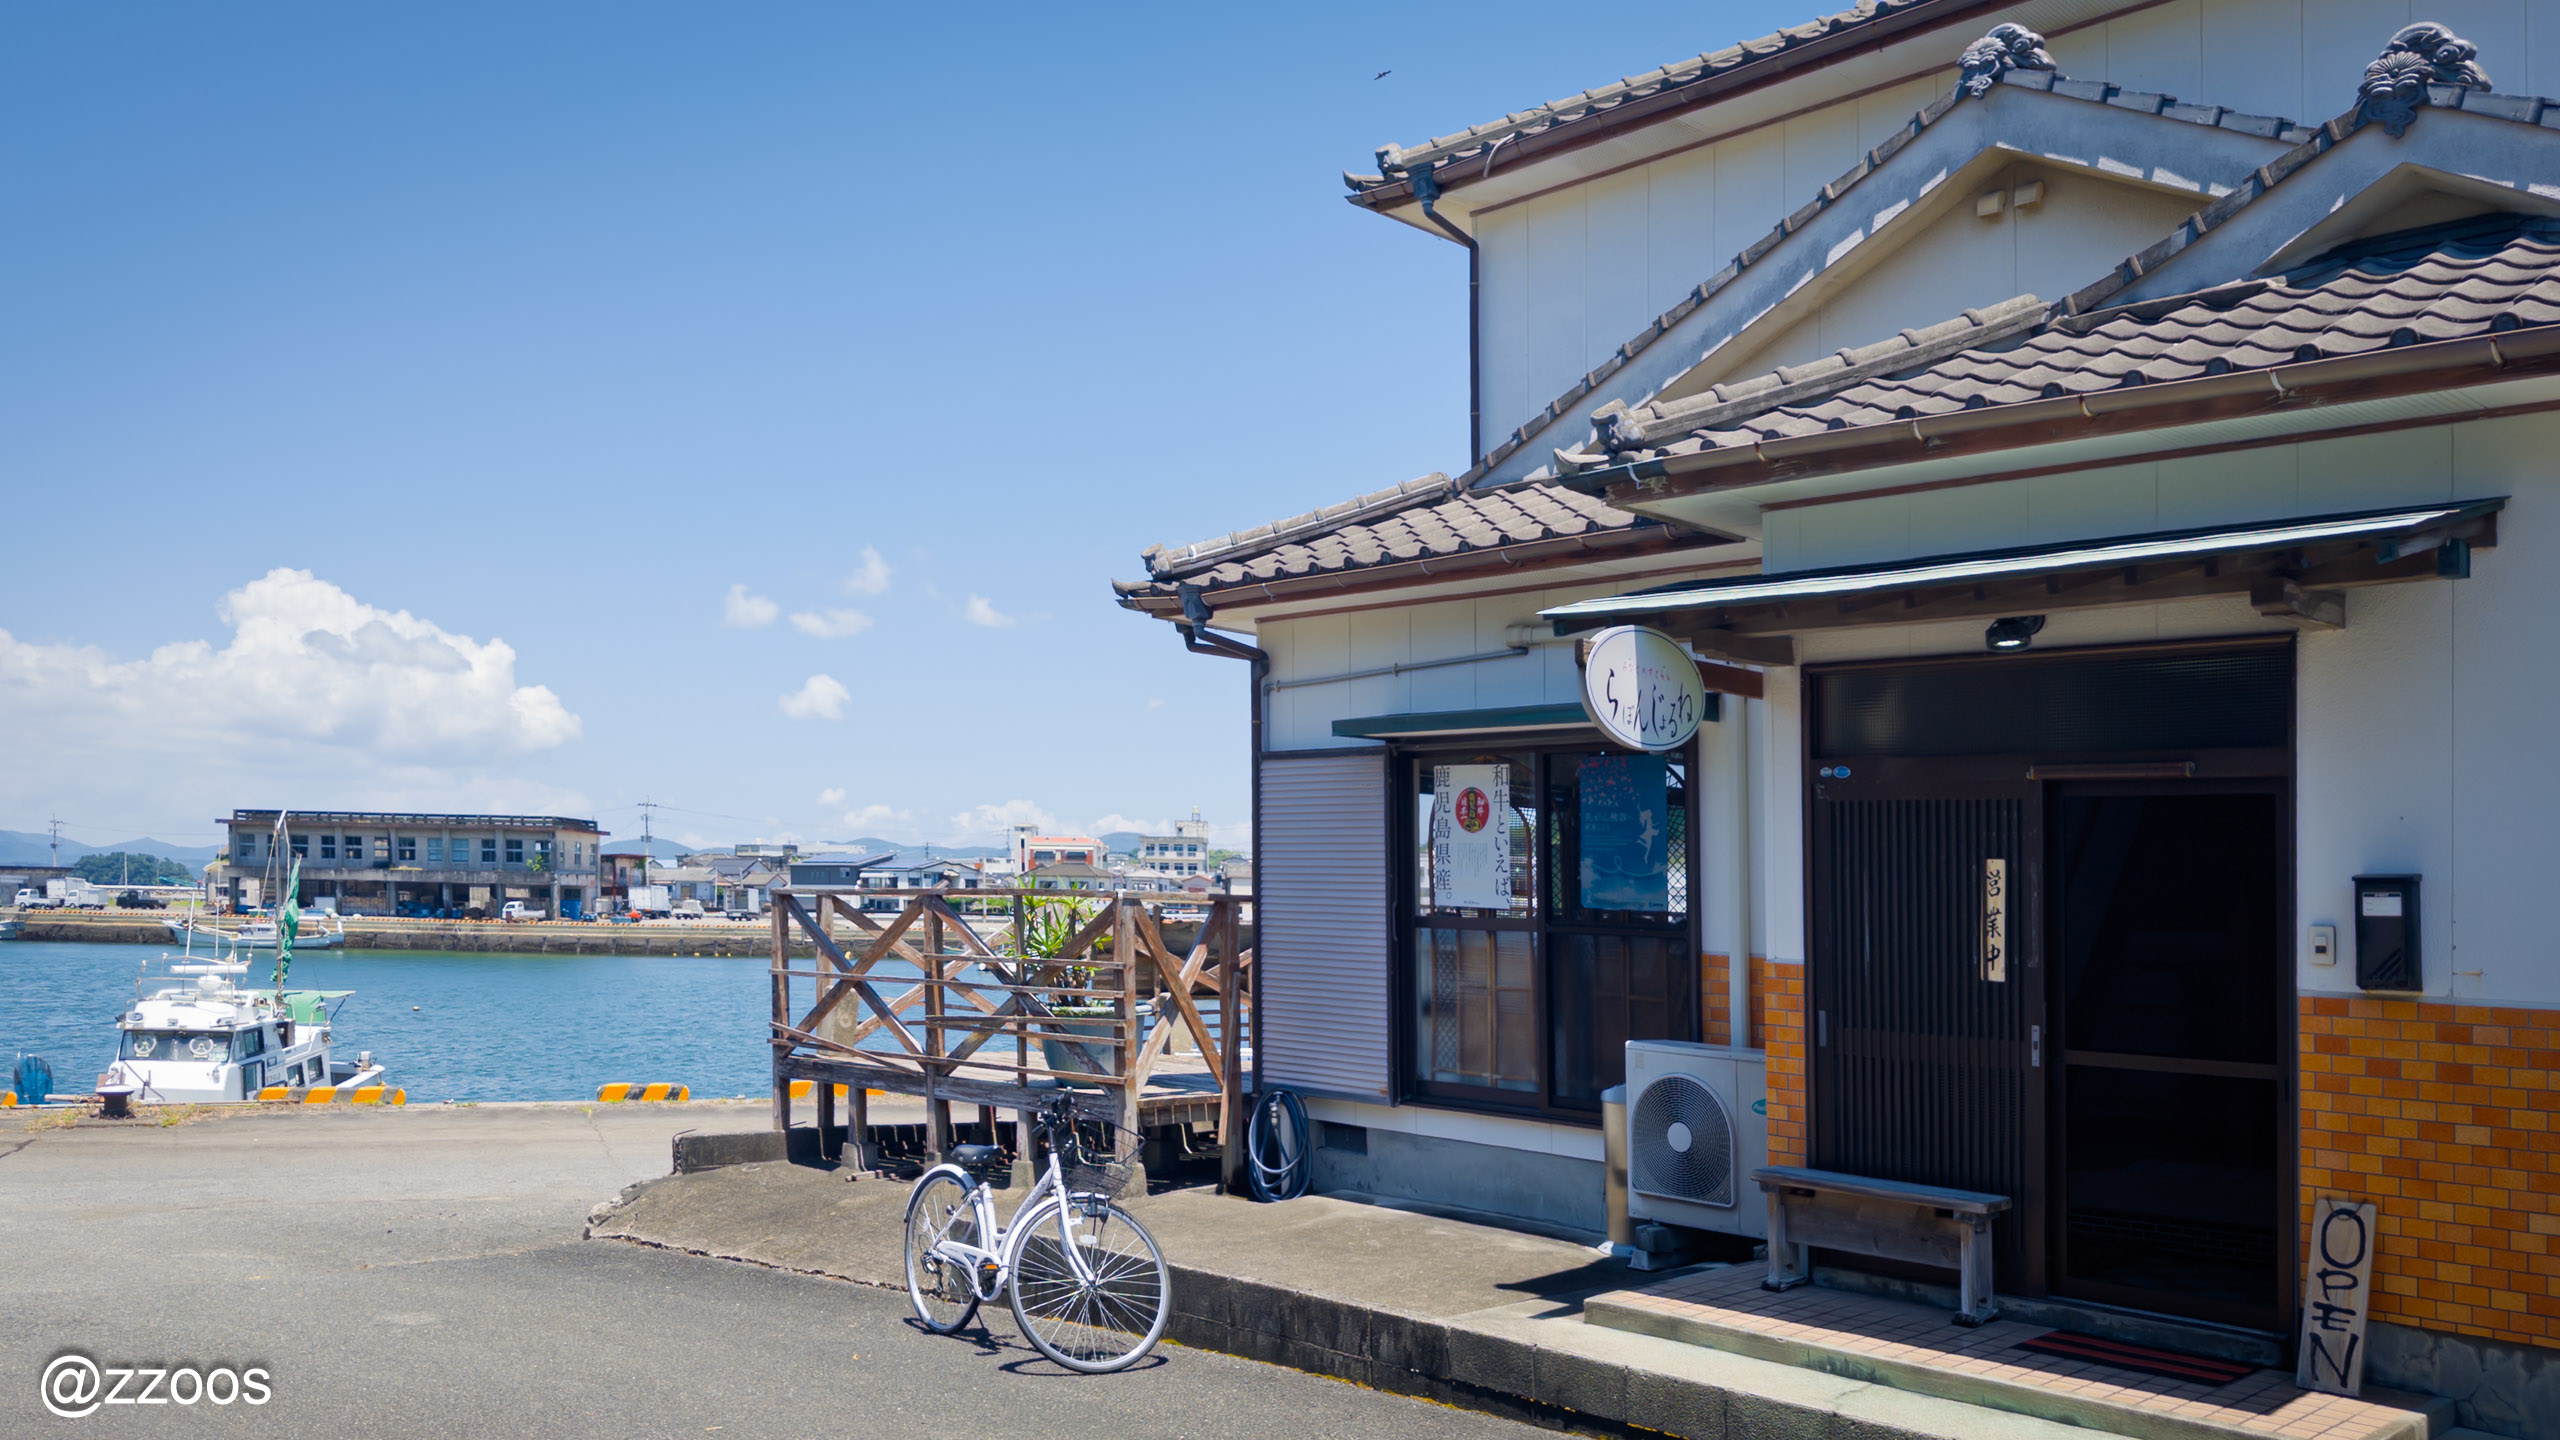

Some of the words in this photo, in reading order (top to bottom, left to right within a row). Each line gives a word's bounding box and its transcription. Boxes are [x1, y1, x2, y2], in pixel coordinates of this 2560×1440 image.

[1435, 766, 1452, 899] 鹿児島県産。
[1492, 764, 1510, 904] 和牛といえば、
[1986, 869, 2001, 971] 営業中
[2309, 1208, 2366, 1388] OPEN
